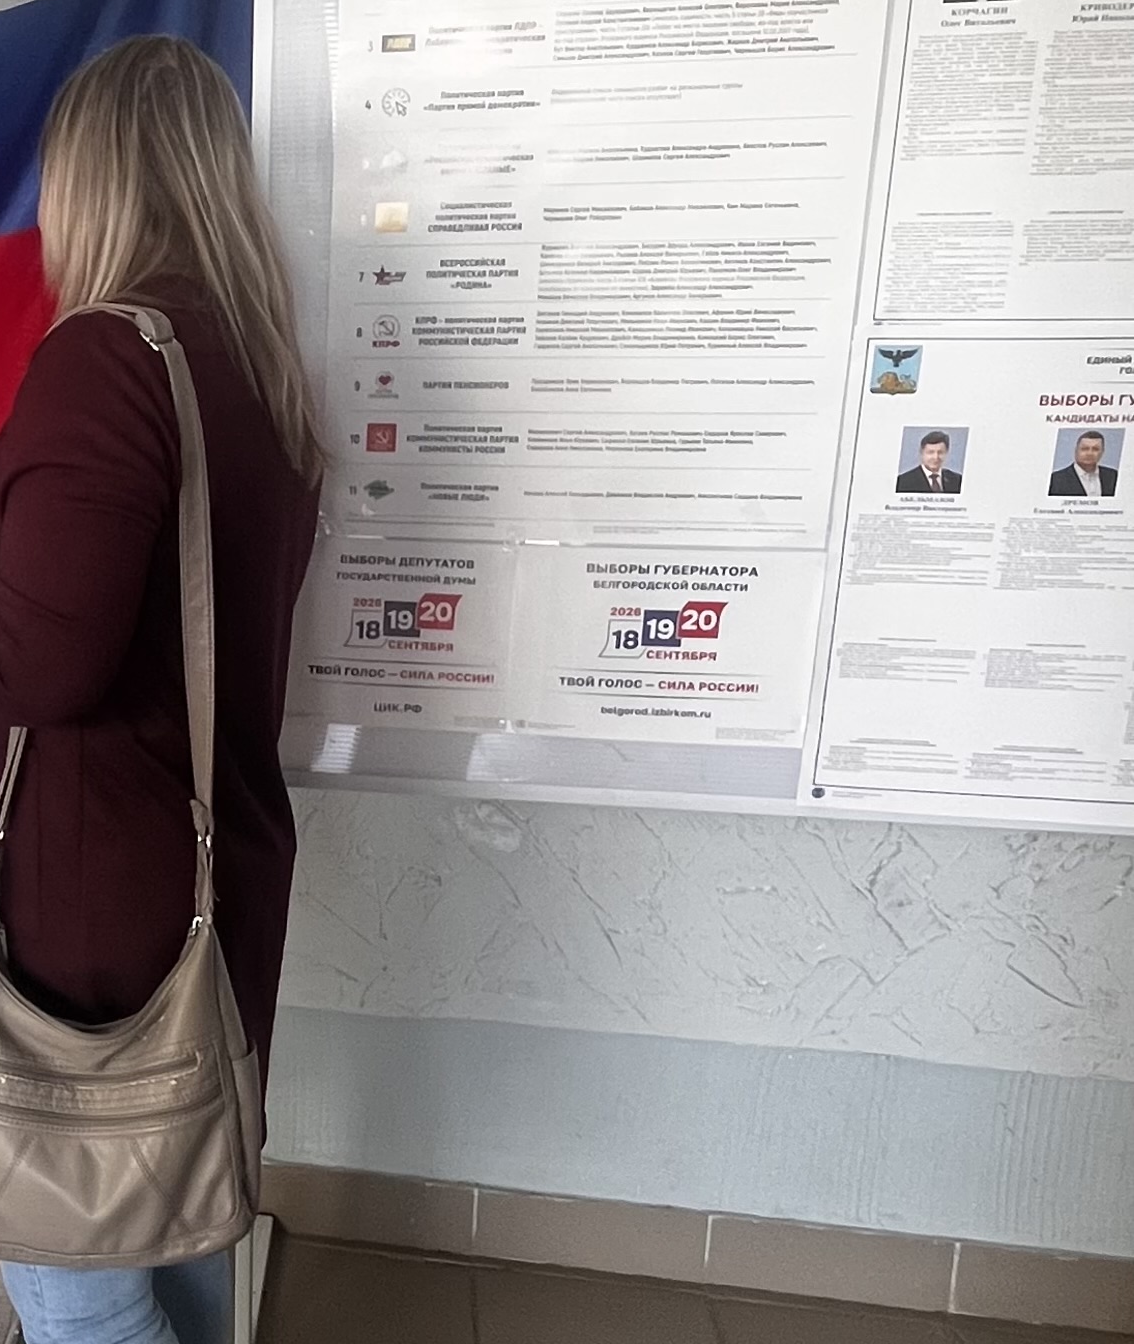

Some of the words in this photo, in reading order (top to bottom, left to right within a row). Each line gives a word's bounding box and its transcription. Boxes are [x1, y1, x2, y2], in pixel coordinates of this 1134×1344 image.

[358, 271, 364, 282] 7
[1086, 354, 1132, 365] ЕДИНЫЙ
[1119, 366, 1134, 376] ГО
[1039, 394, 1115, 407] ВЫБОРЫ
[1045, 414, 1120, 423] КАНДИДАТЫ
[340, 554, 396, 566] ВЫБОРЫ
[398, 557, 475, 569] ДЕПУТАТОВ
[586, 563, 650, 575] ВЫБОРЫ
[653, 565, 759, 577] ГУБЕРНАТОРА
[336, 572, 441, 584] ГОСУДАРСТВЕННОЙ
[443, 576, 476, 585] ДУМЫ
[593, 580, 689, 591] БЕЛГОРОДСКОЙ
[691, 581, 749, 592] ОБЛАСТИ
[353, 598, 382, 607] 2026
[610, 607, 642, 617] 2026
[355, 620, 380, 640] 18
[387, 610, 413, 630] 19
[419, 601, 453, 622] 20
[611, 629, 639, 650] 18
[646, 618, 675, 640] 19
[681, 609, 717, 631] 20
[388, 640, 454, 652] СЕНТЯБРЯ
[646, 650, 717, 662] СЕНТЯБРЯ
[308, 664, 342, 676] ТВОЙ
[344, 667, 386, 678] ГОЛОС
[399, 671, 434, 681] СИЛА
[437, 673, 495, 683] РОССИИ!
[559, 676, 595, 688] ТВОЙ
[598, 678, 643, 689] ГОЛОС
[658, 681, 695, 692] СИЛА
[698, 682, 760, 693] РОССИИ!
[373, 702, 422, 713] ЦИК.РФ
[600, 706, 712, 720] belgorod.izbirkom.ru
